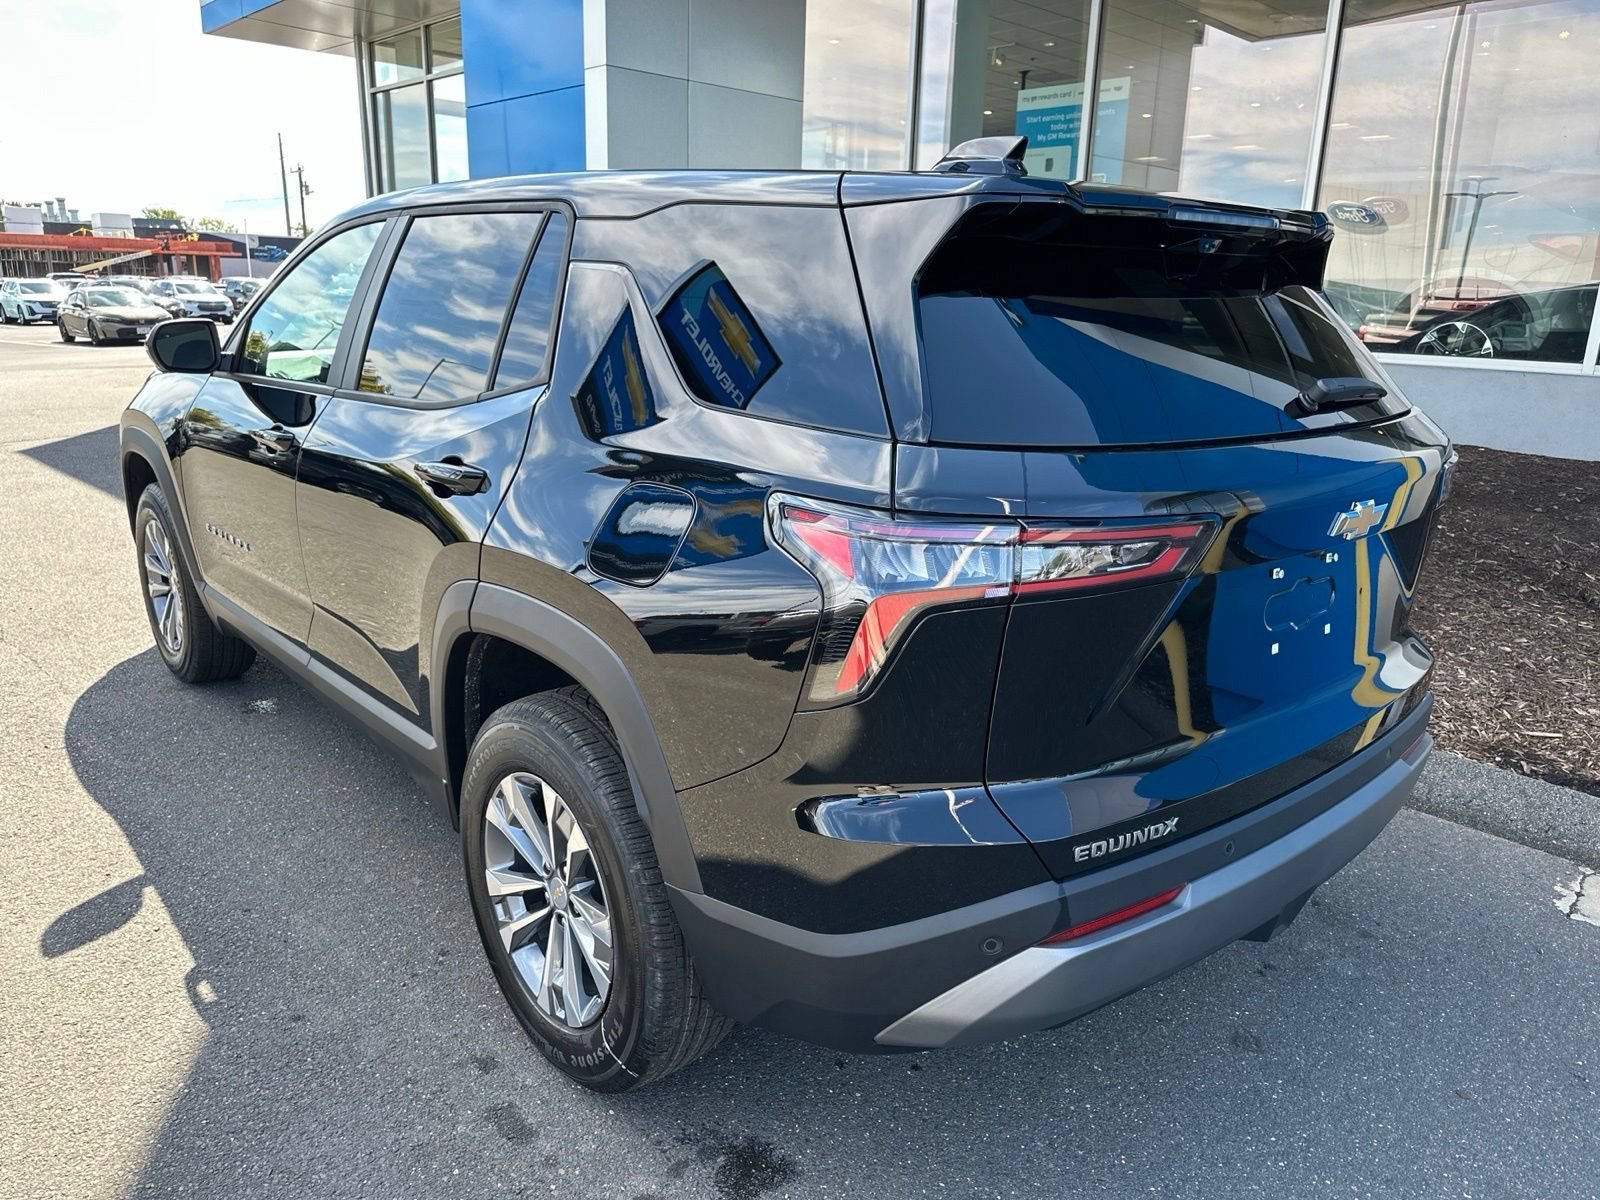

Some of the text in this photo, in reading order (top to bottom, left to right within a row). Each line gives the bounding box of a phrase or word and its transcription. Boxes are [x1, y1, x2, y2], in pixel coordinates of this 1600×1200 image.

[1026, 115, 1041, 123] Start
[1042, 113, 1065, 122] earning
[1050, 122, 1068, 131] today
[1073, 816, 1179, 863] EQUINOX
